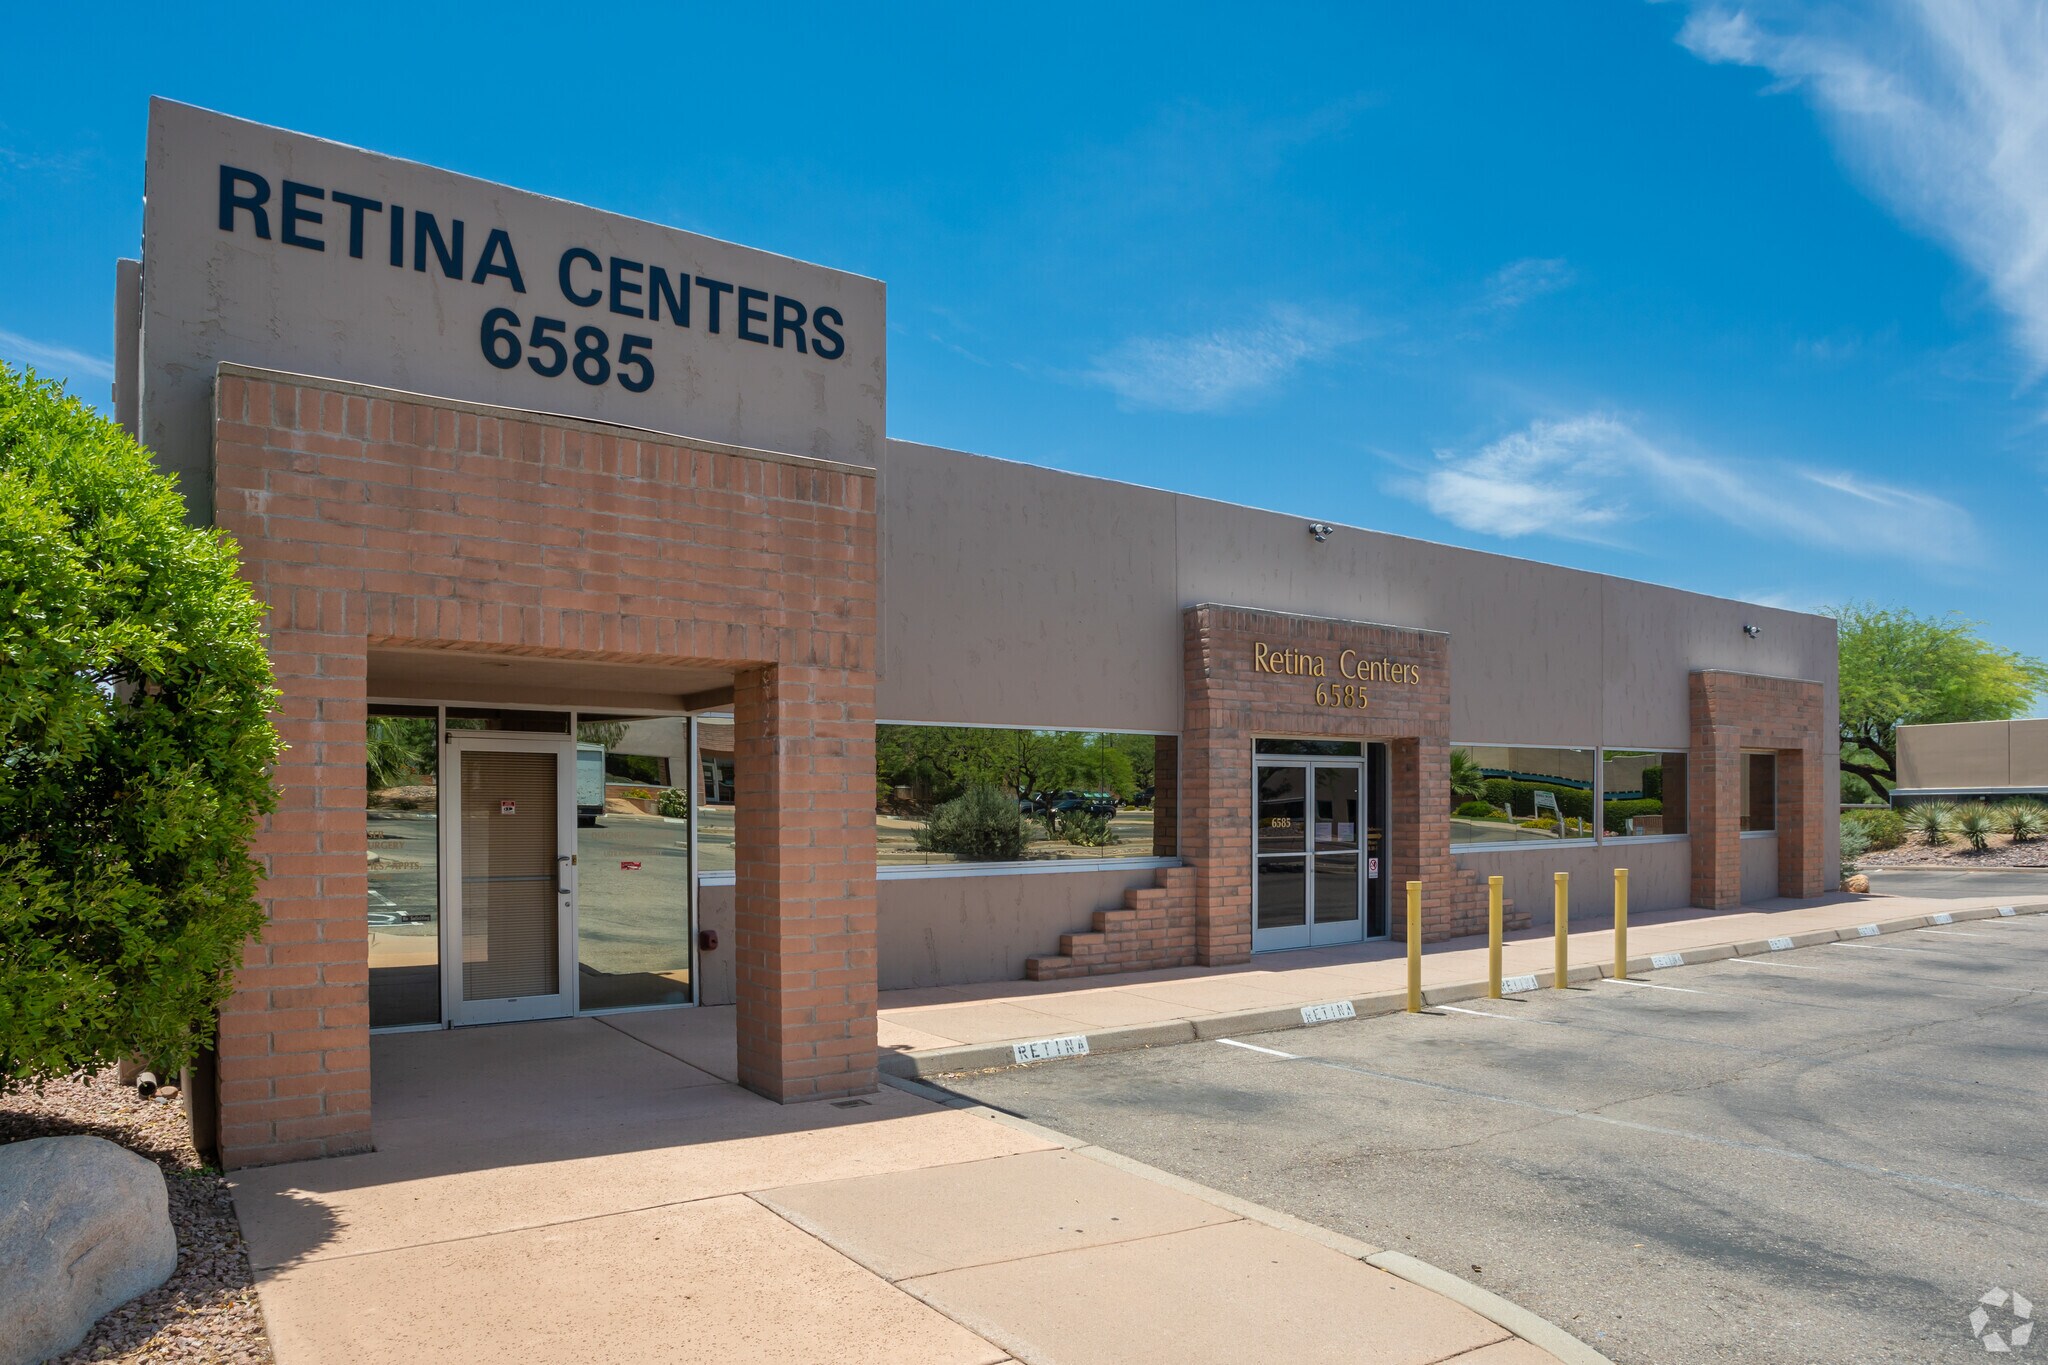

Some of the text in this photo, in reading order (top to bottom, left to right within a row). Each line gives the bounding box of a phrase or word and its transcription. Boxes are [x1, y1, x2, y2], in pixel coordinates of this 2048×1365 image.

[218, 163, 846, 361] RETINA CENTERS
[480, 307, 656, 393] 6585
[1254, 641, 1420, 686] Retina Centers
[1315, 682, 1369, 710] 6585
[1271, 817, 1291, 828] 6585
[367, 830, 384, 839] SER
[367, 840, 405, 850] URGERY
[1304, 1003, 1354, 1023] RETINA
[1017, 1039, 1086, 1060] RETINA
